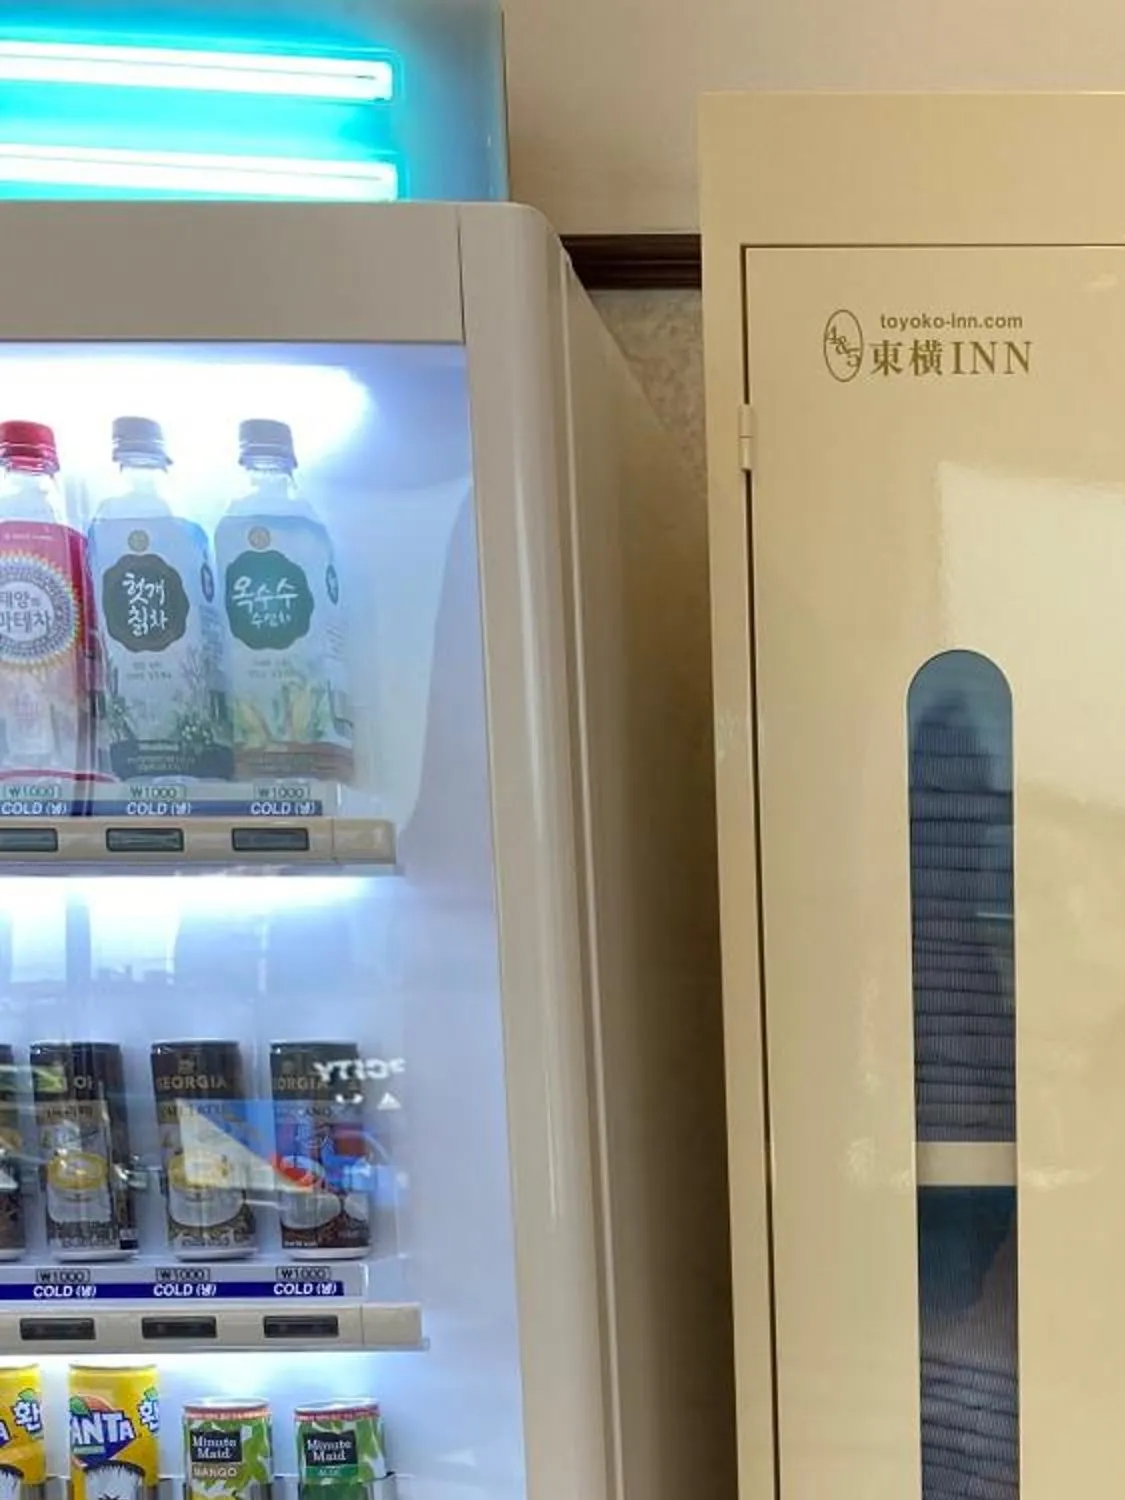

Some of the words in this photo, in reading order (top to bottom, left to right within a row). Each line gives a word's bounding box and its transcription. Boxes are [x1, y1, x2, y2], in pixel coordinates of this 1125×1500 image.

[880, 313, 1024, 332] toyoko-inn.com
[232, 576, 299, 614] 옥수수
[1, 802, 42, 815] COLD
[127, 802, 167, 815] COLD
[250, 802, 291, 815] COLD
[33, 1285, 73, 1298] COLD
[152, 1284, 193, 1297] COLD
[273, 1283, 314, 1296] COLD
[71, 1412, 135, 1445] ANTA
[191, 1435, 237, 1447] Minute
[307, 1439, 352, 1450] Minute
[197, 1447, 232, 1459] Maid
[313, 1450, 347, 1461] Maid
[193, 1466, 238, 1478] MANGO
